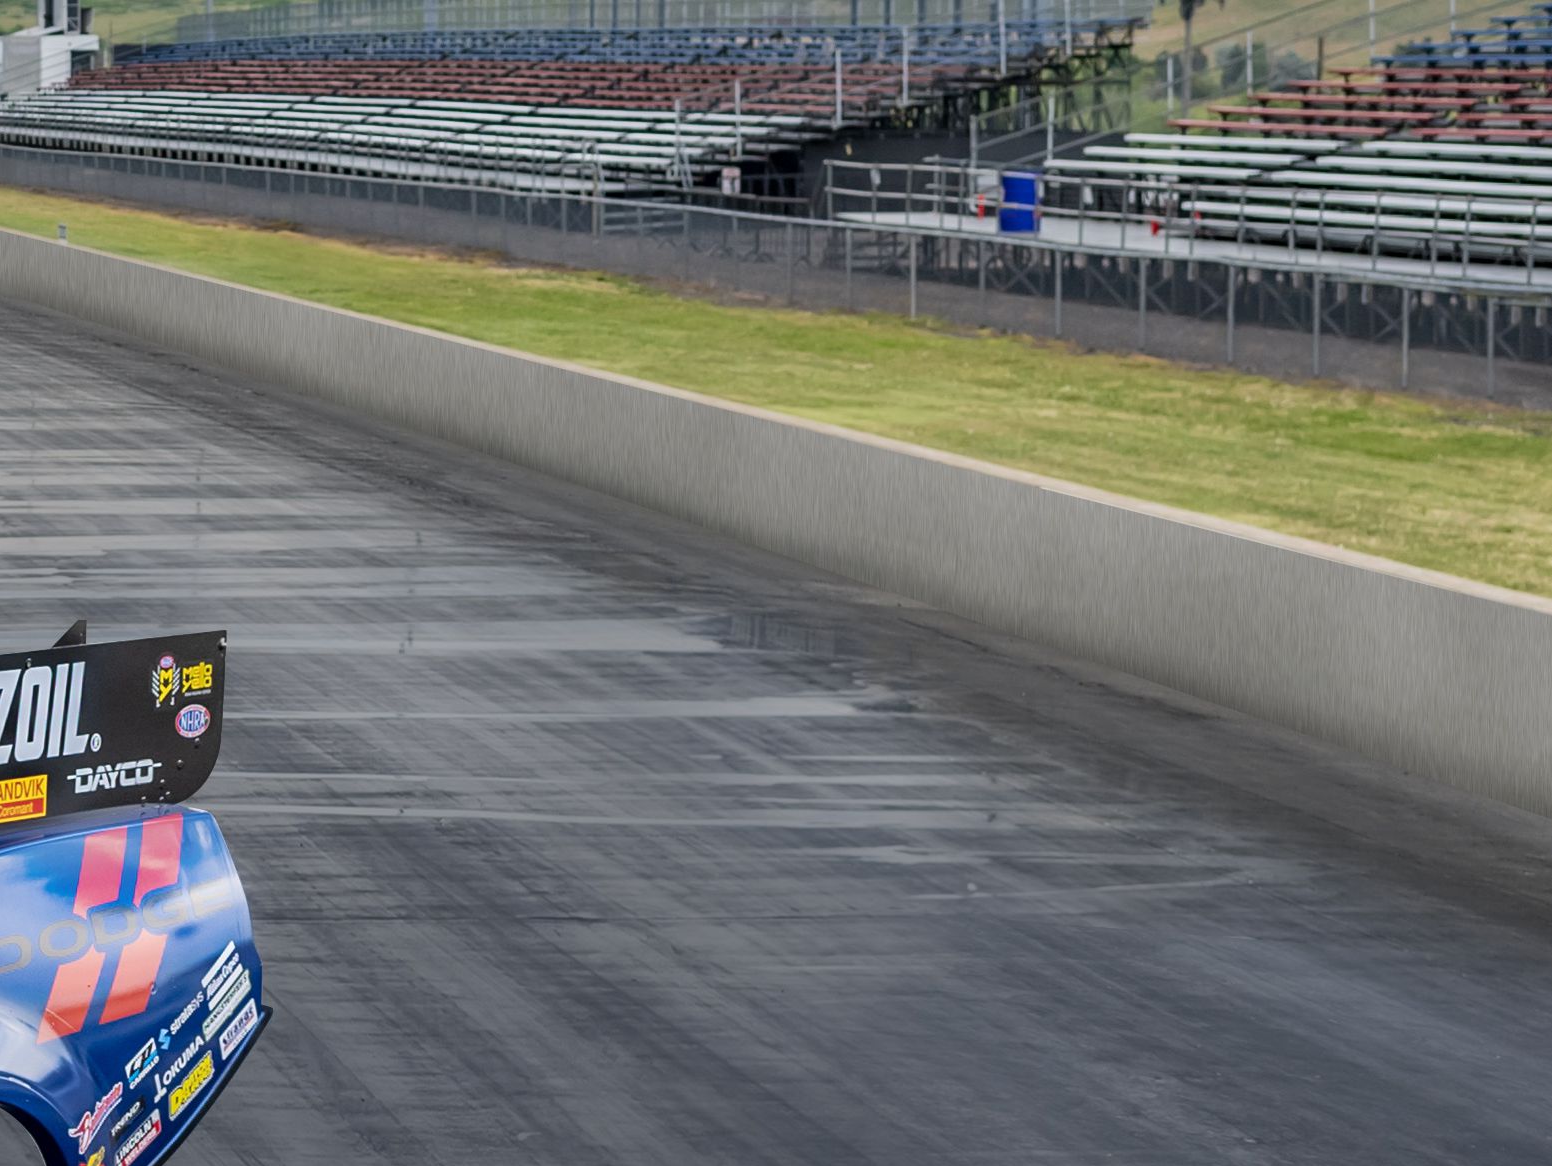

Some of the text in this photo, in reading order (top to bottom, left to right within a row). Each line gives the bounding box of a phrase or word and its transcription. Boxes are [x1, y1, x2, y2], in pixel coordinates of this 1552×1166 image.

[180, 709, 207, 732] NHRA
[162, 1034, 206, 1086] OKUMA
[116, 1115, 153, 1161] LINCOLN
